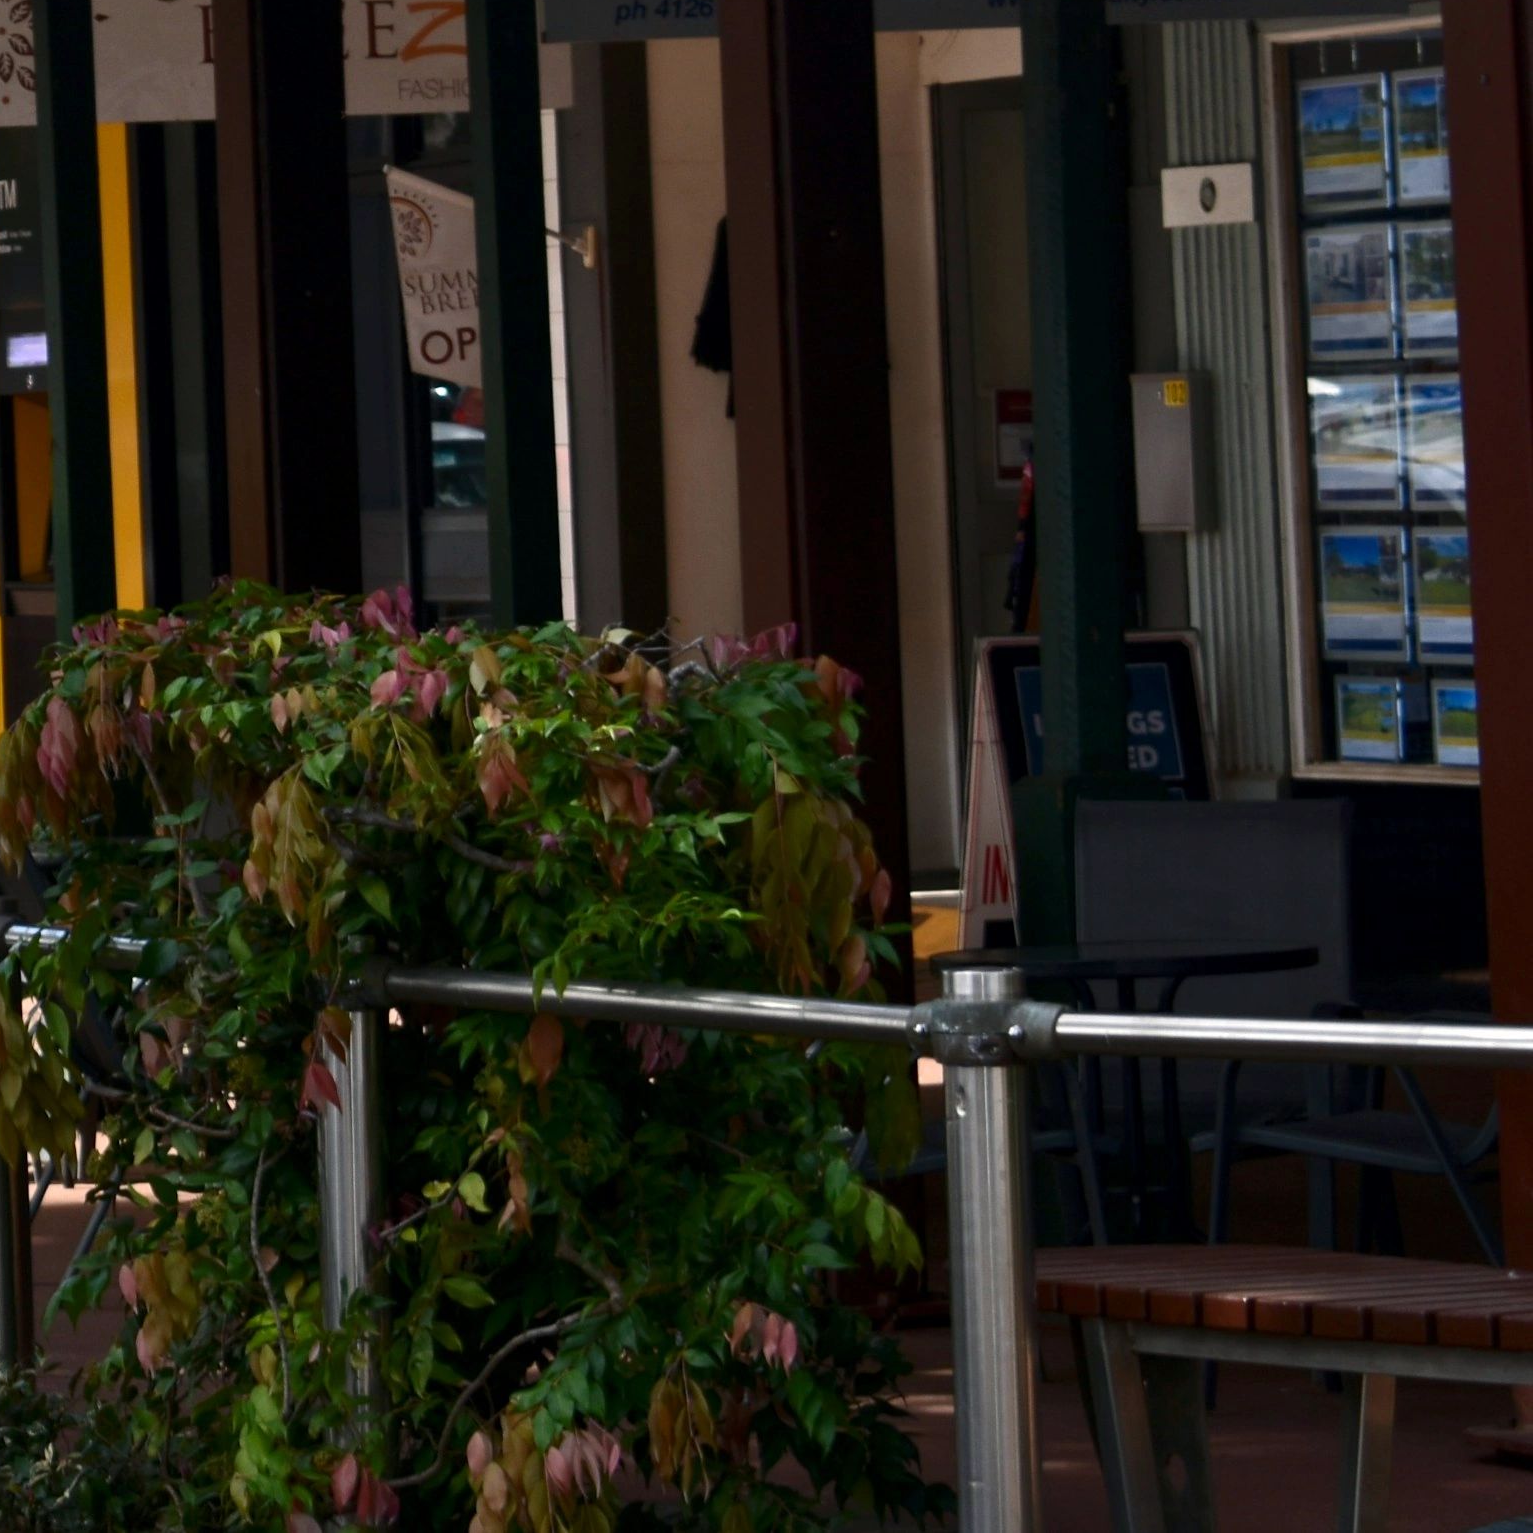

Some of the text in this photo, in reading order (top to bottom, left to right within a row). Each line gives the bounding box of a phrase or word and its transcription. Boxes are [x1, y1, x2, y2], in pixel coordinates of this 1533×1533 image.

[615, 0, 647, 26] ph
[397, 77, 470, 102] FASHI
[404, 269, 478, 297] SUM
[421, 289, 479, 314] BRE
[421, 327, 477, 364] OP
